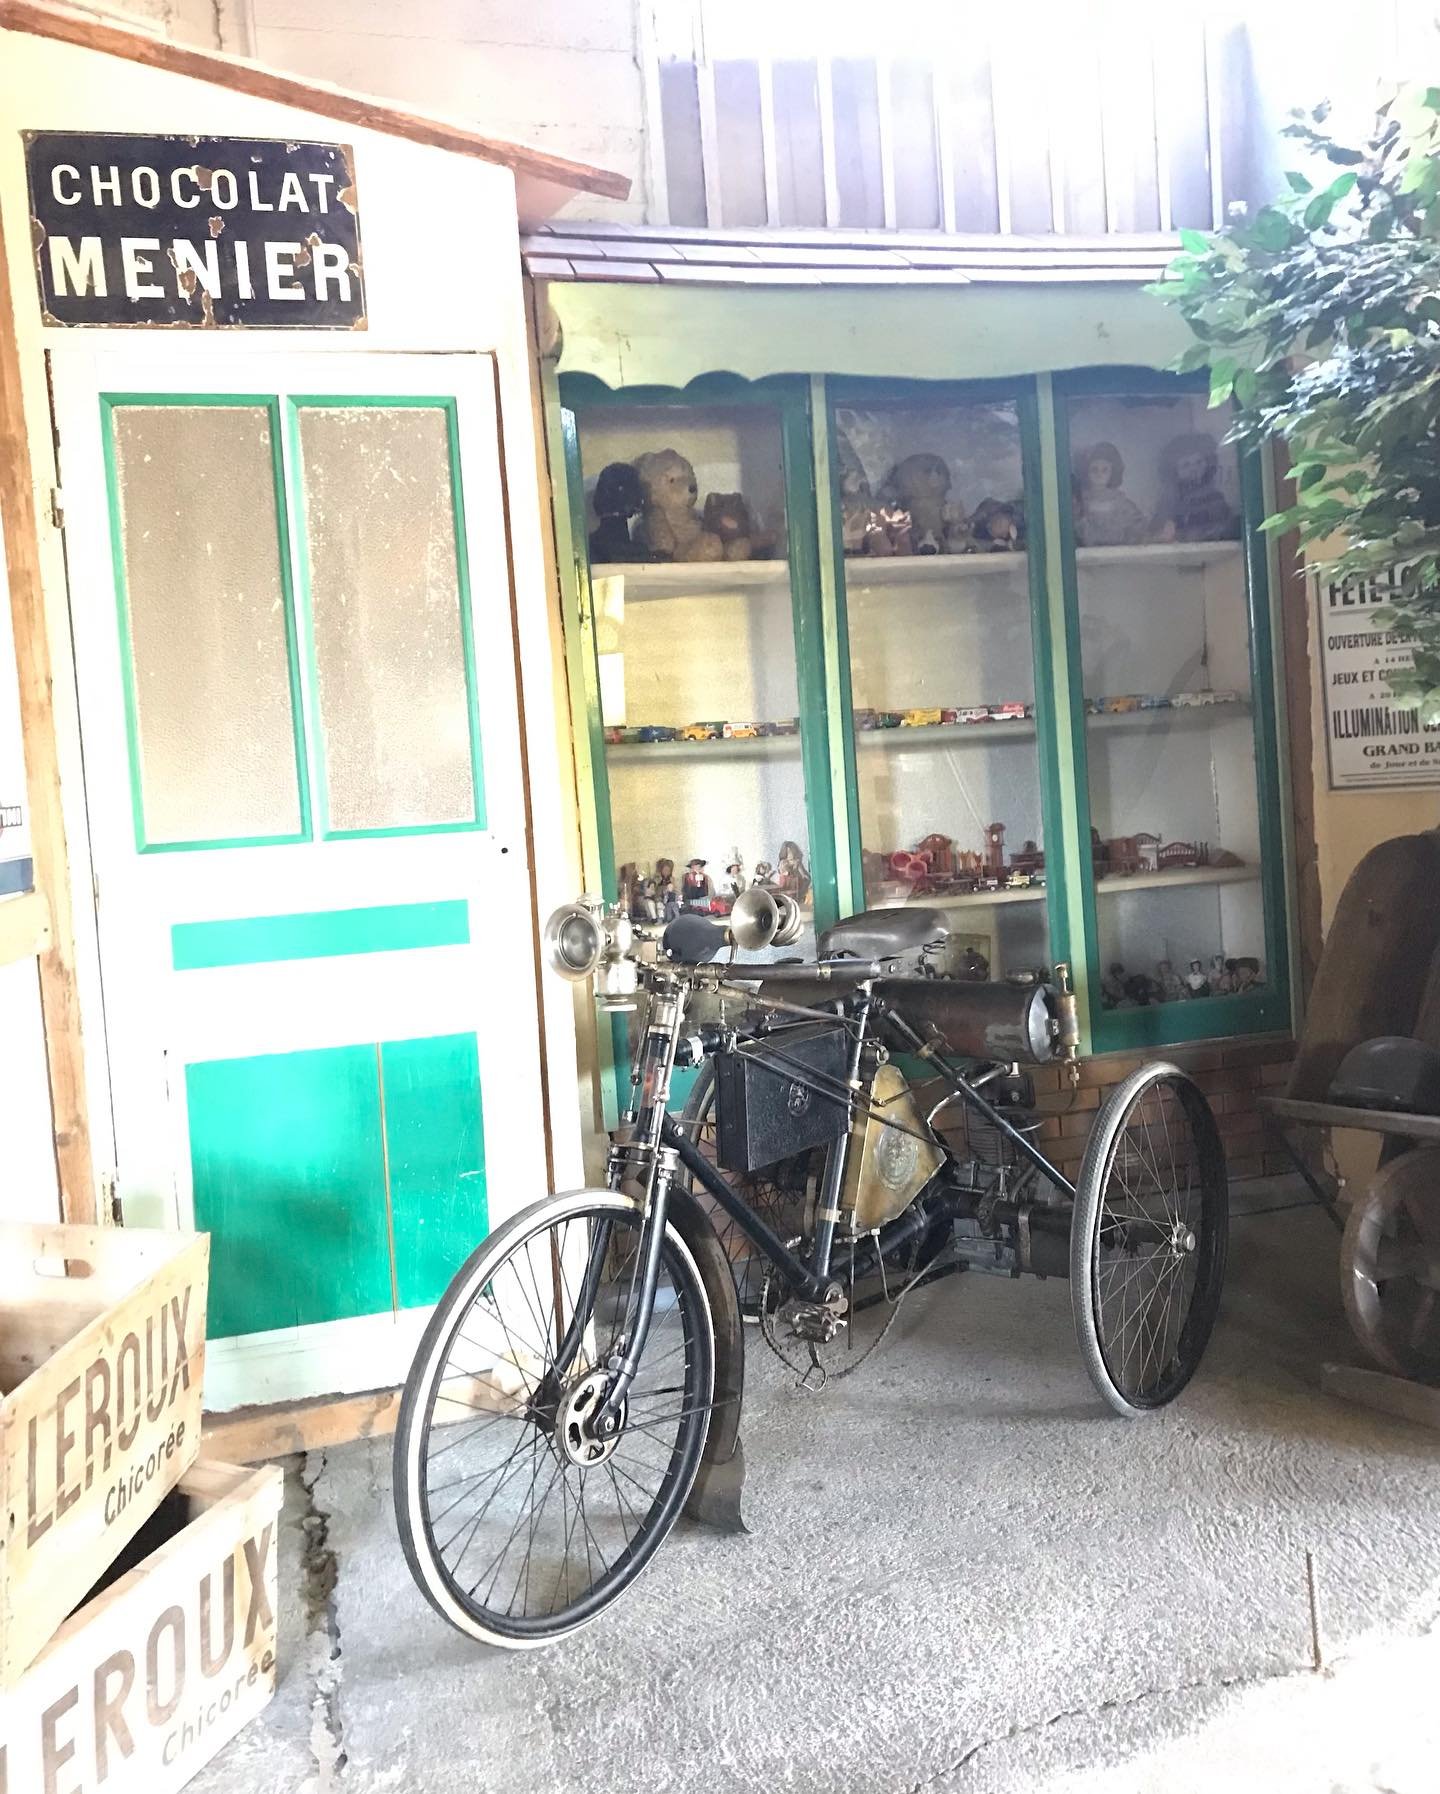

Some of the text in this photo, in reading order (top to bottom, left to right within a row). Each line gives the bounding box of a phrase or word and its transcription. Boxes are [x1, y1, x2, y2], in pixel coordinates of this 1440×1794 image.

[51, 164, 335, 214] CHOCOLAT
[48, 235, 352, 302] MENIER
[1328, 632, 1383, 650] OUVERTURE
[1333, 672, 1358, 685] JEUX
[1362, 670, 1374, 682] ET
[1363, 743, 1420, 757] GRAND
[27, 1284, 192, 1550] LEROUX
[103, 1420, 186, 1526] Chicorée
[161, 1649, 276, 1768] Chicorée
